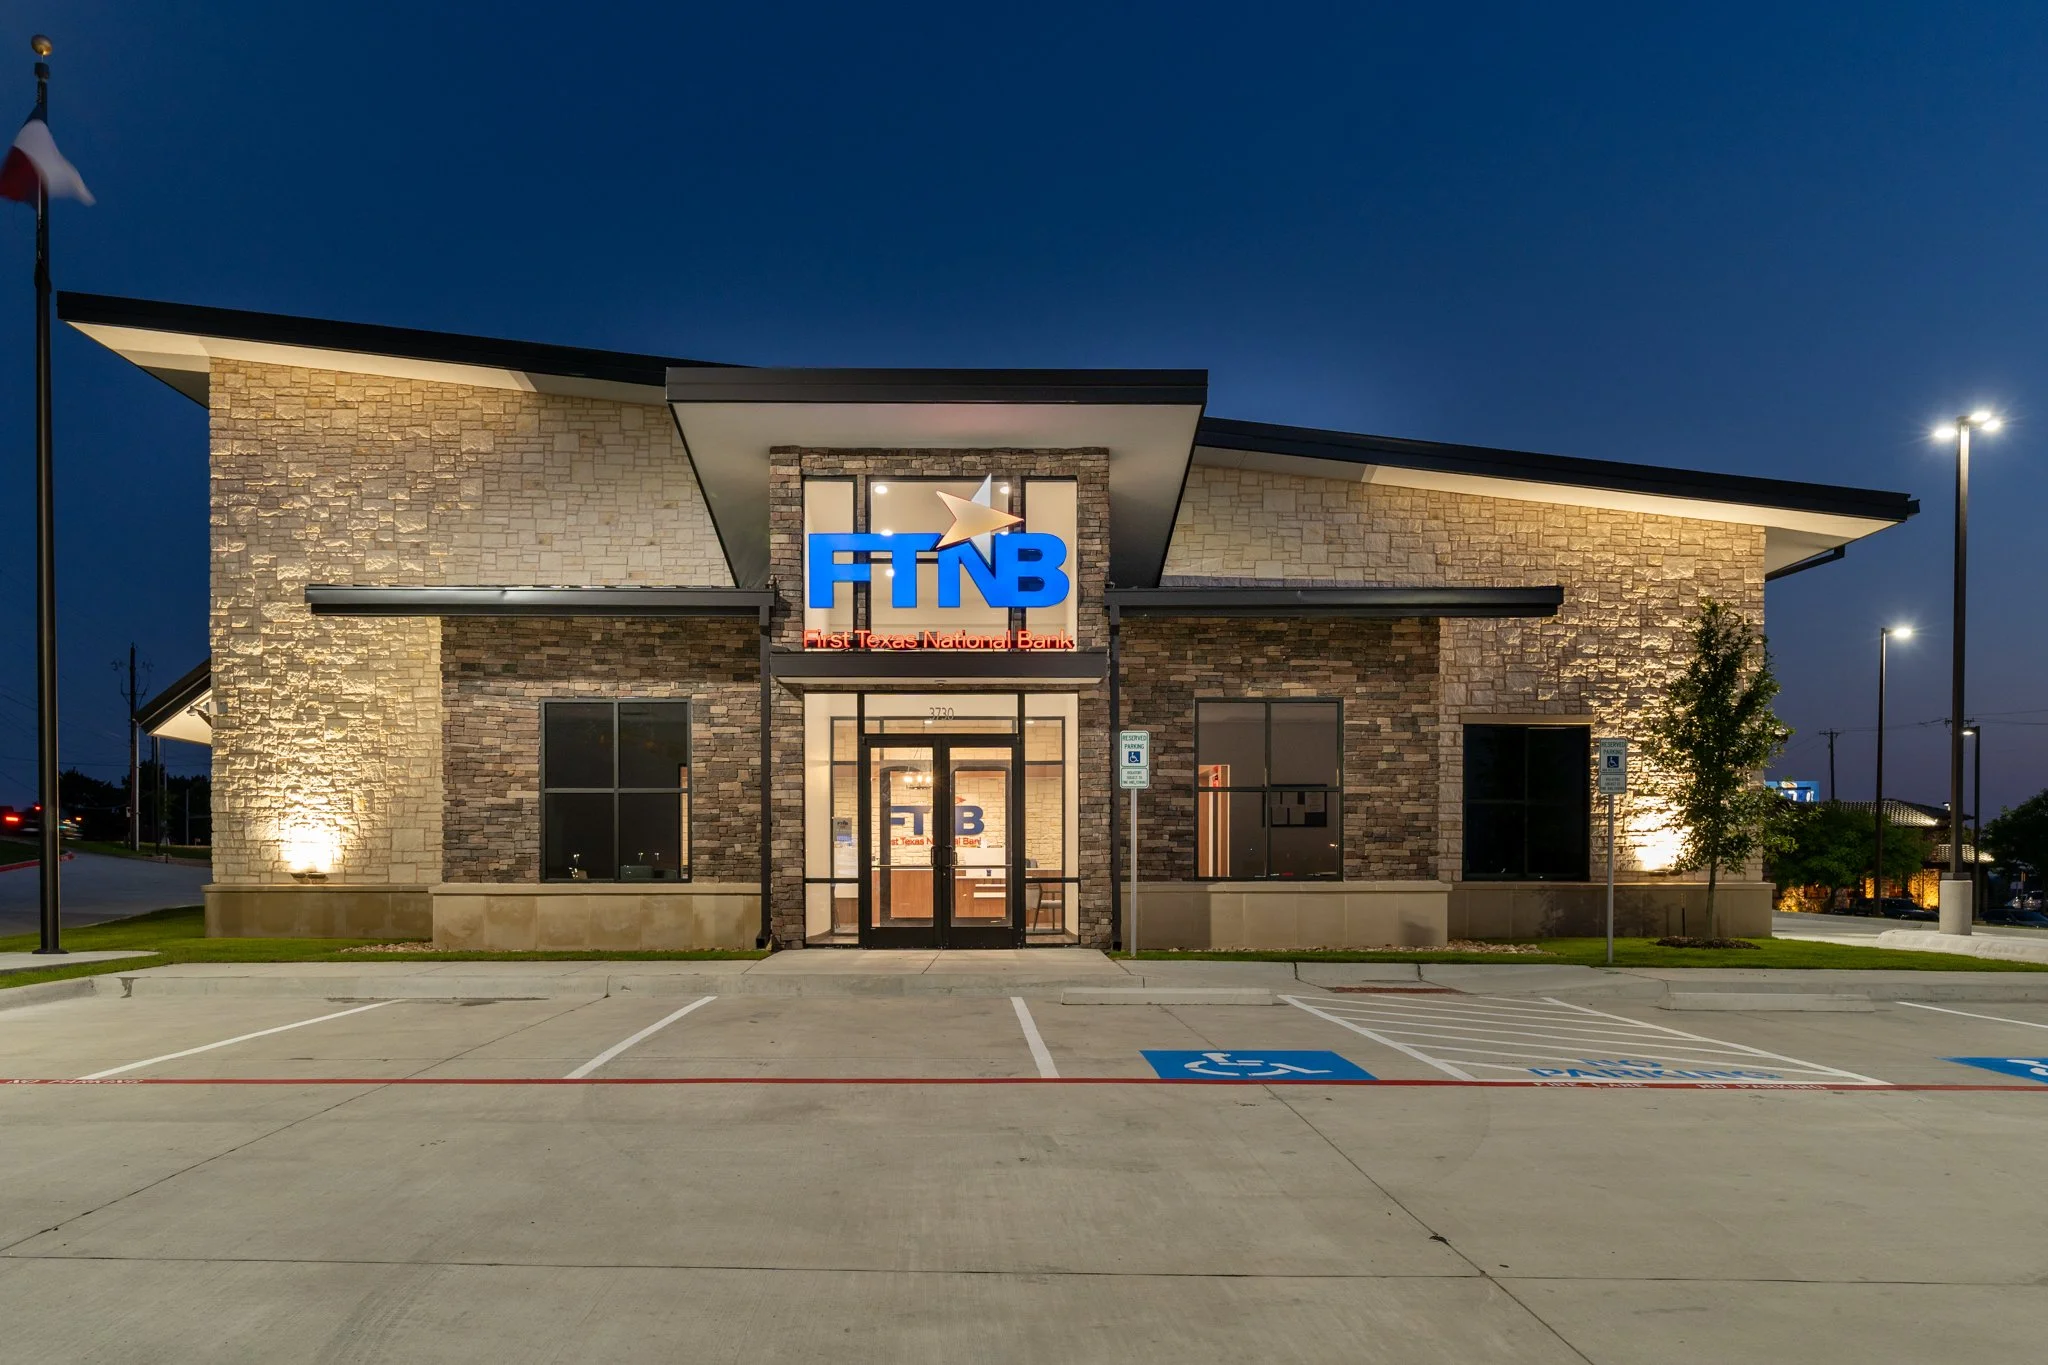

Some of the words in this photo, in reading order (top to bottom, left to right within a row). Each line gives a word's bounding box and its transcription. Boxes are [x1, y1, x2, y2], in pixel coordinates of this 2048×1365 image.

[808, 533, 1070, 608] FTNB
[803, 630, 851, 649] First
[855, 630, 917, 649] Texas
[923, 630, 1012, 649] National
[1017, 630, 1075, 649] Bank
[929, 707, 954, 720] 3730
[890, 806, 984, 836] FTB
[900, 837, 924, 846] Texas
[1578, 1058, 1663, 1068] NO
[1527, 1068, 1783, 1079] PARKING
